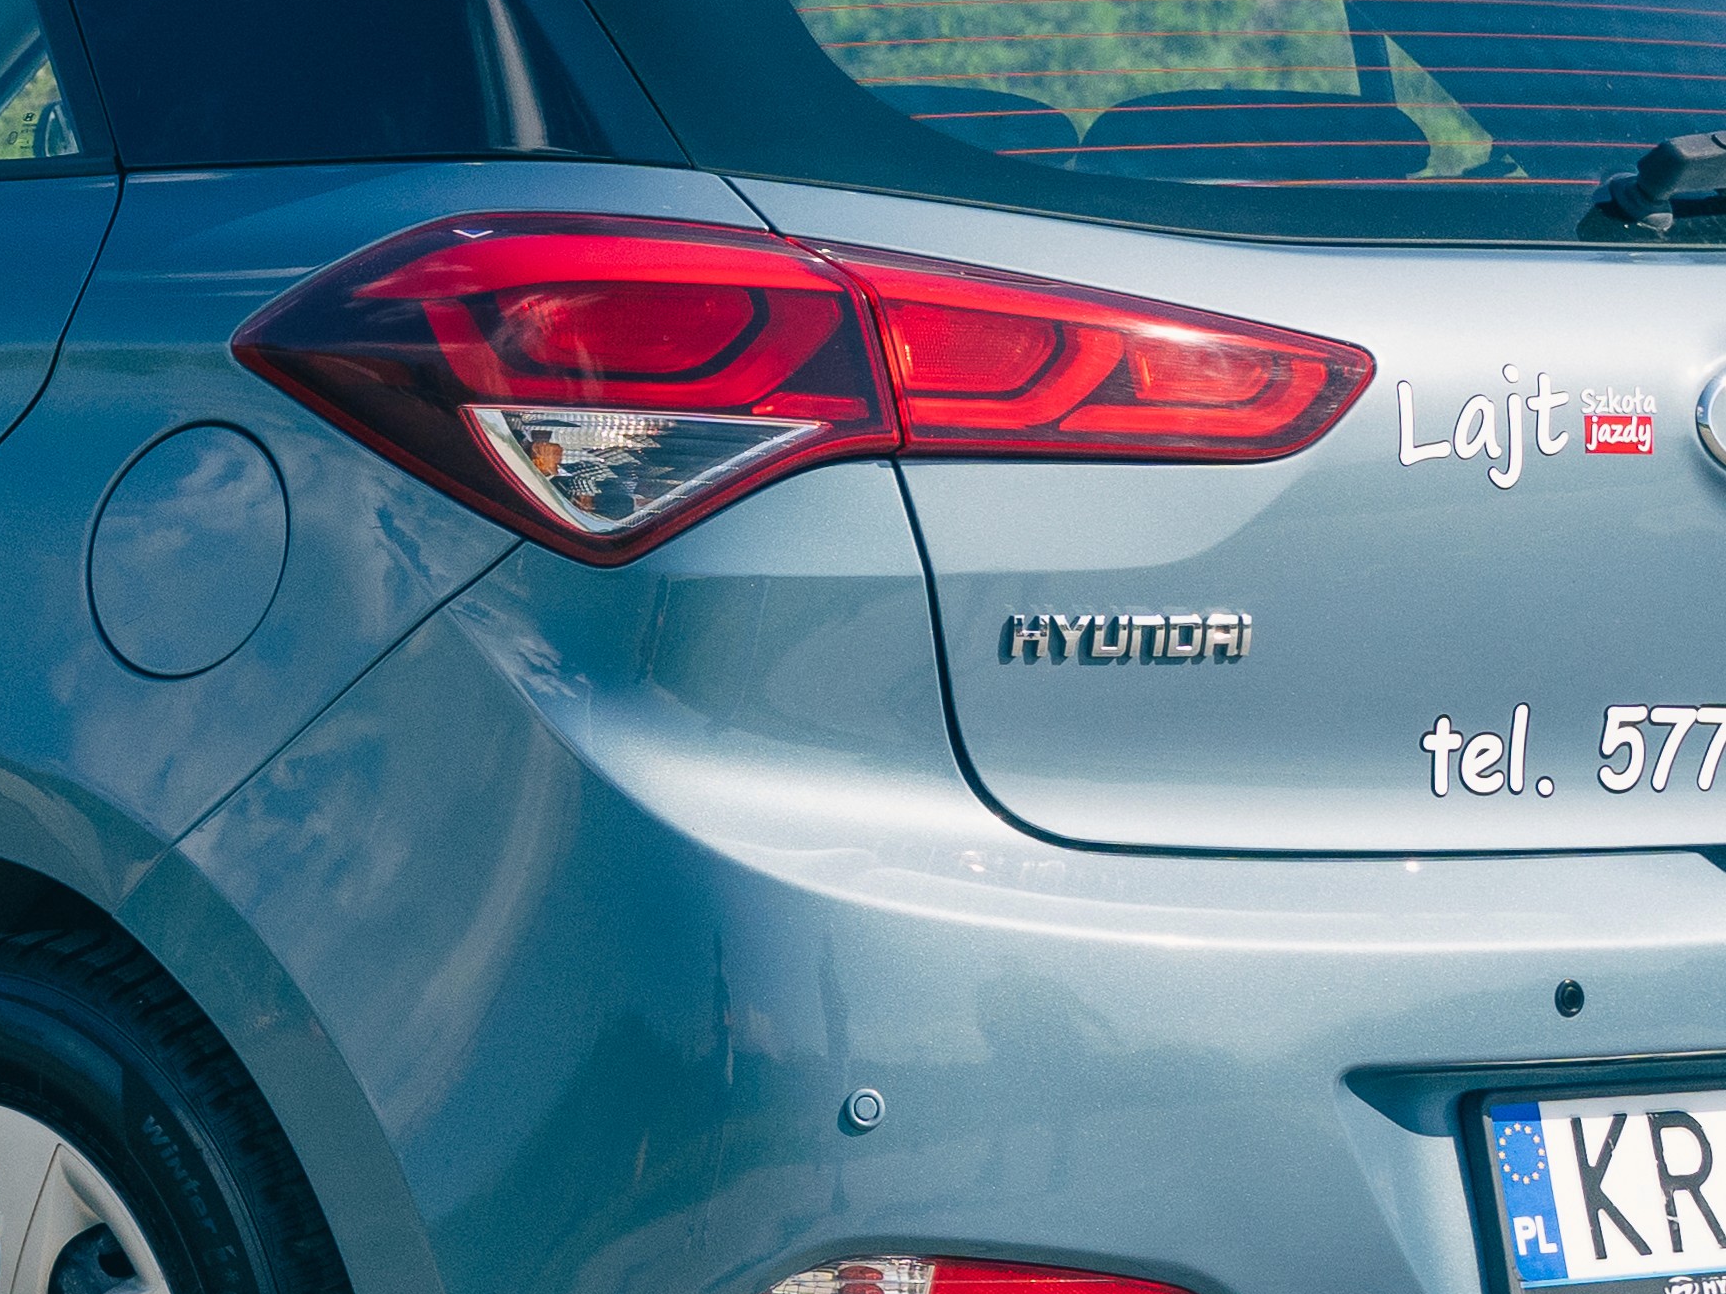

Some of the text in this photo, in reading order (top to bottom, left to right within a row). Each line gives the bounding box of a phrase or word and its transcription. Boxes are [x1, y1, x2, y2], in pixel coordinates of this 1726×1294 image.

[1580, 386, 1658, 415] Szkoła
[1396, 363, 1570, 490] Lajt
[1586, 416, 1652, 452] jazdy
[1010, 613, 1253, 658] HYUNDAI
[1419, 702, 1726, 798] tel. 577
[1570, 1110, 1726, 1260] KR
[1513, 1215, 1558, 1256] PL
